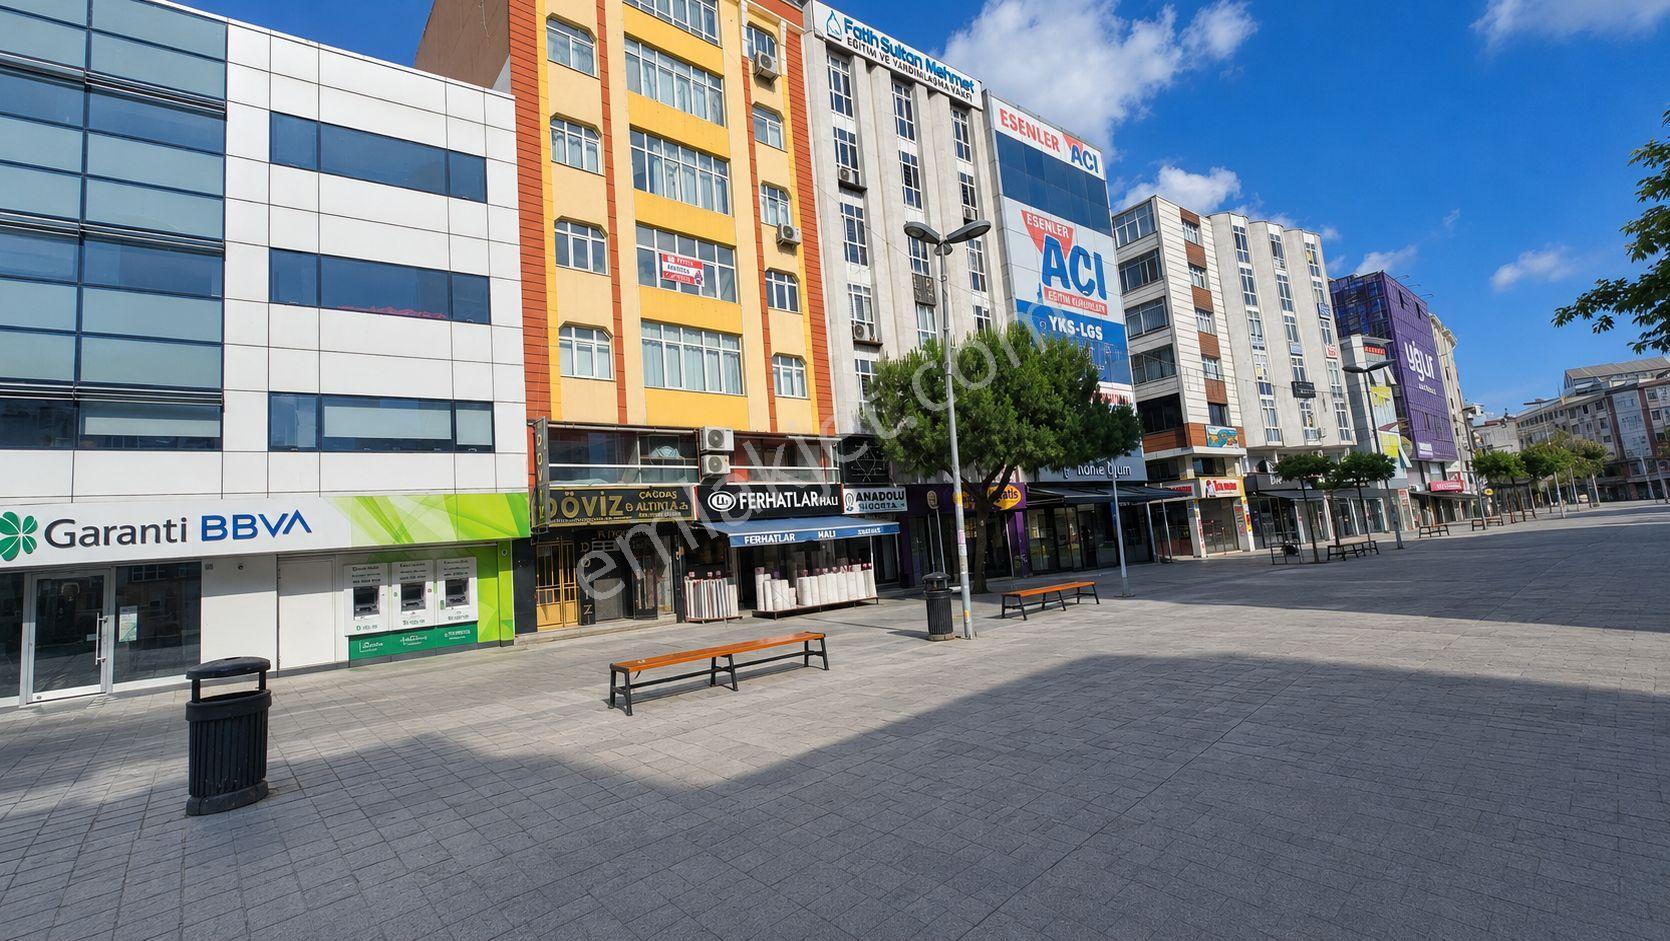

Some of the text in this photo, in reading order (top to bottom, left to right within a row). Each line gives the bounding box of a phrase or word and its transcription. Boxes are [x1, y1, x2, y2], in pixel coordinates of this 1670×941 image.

[879, 52, 891, 65] VE
[881, 37, 924, 69] Sultan
[925, 57, 975, 93] Mehmet
[999, 107, 1099, 174] ESENLER ACI
[1026, 213, 1070, 239] ESENLER
[1042, 234, 1108, 301] ACI
[1048, 315, 1103, 341] YKS-LGS
[739, 492, 819, 510] FERHATLAR
[819, 496, 838, 506] HALI
[855, 490, 905, 503] ANADOLU
[44, 509, 312, 549] Garanti BBVA
[744, 529, 836, 545] FERHATLAR HALI
